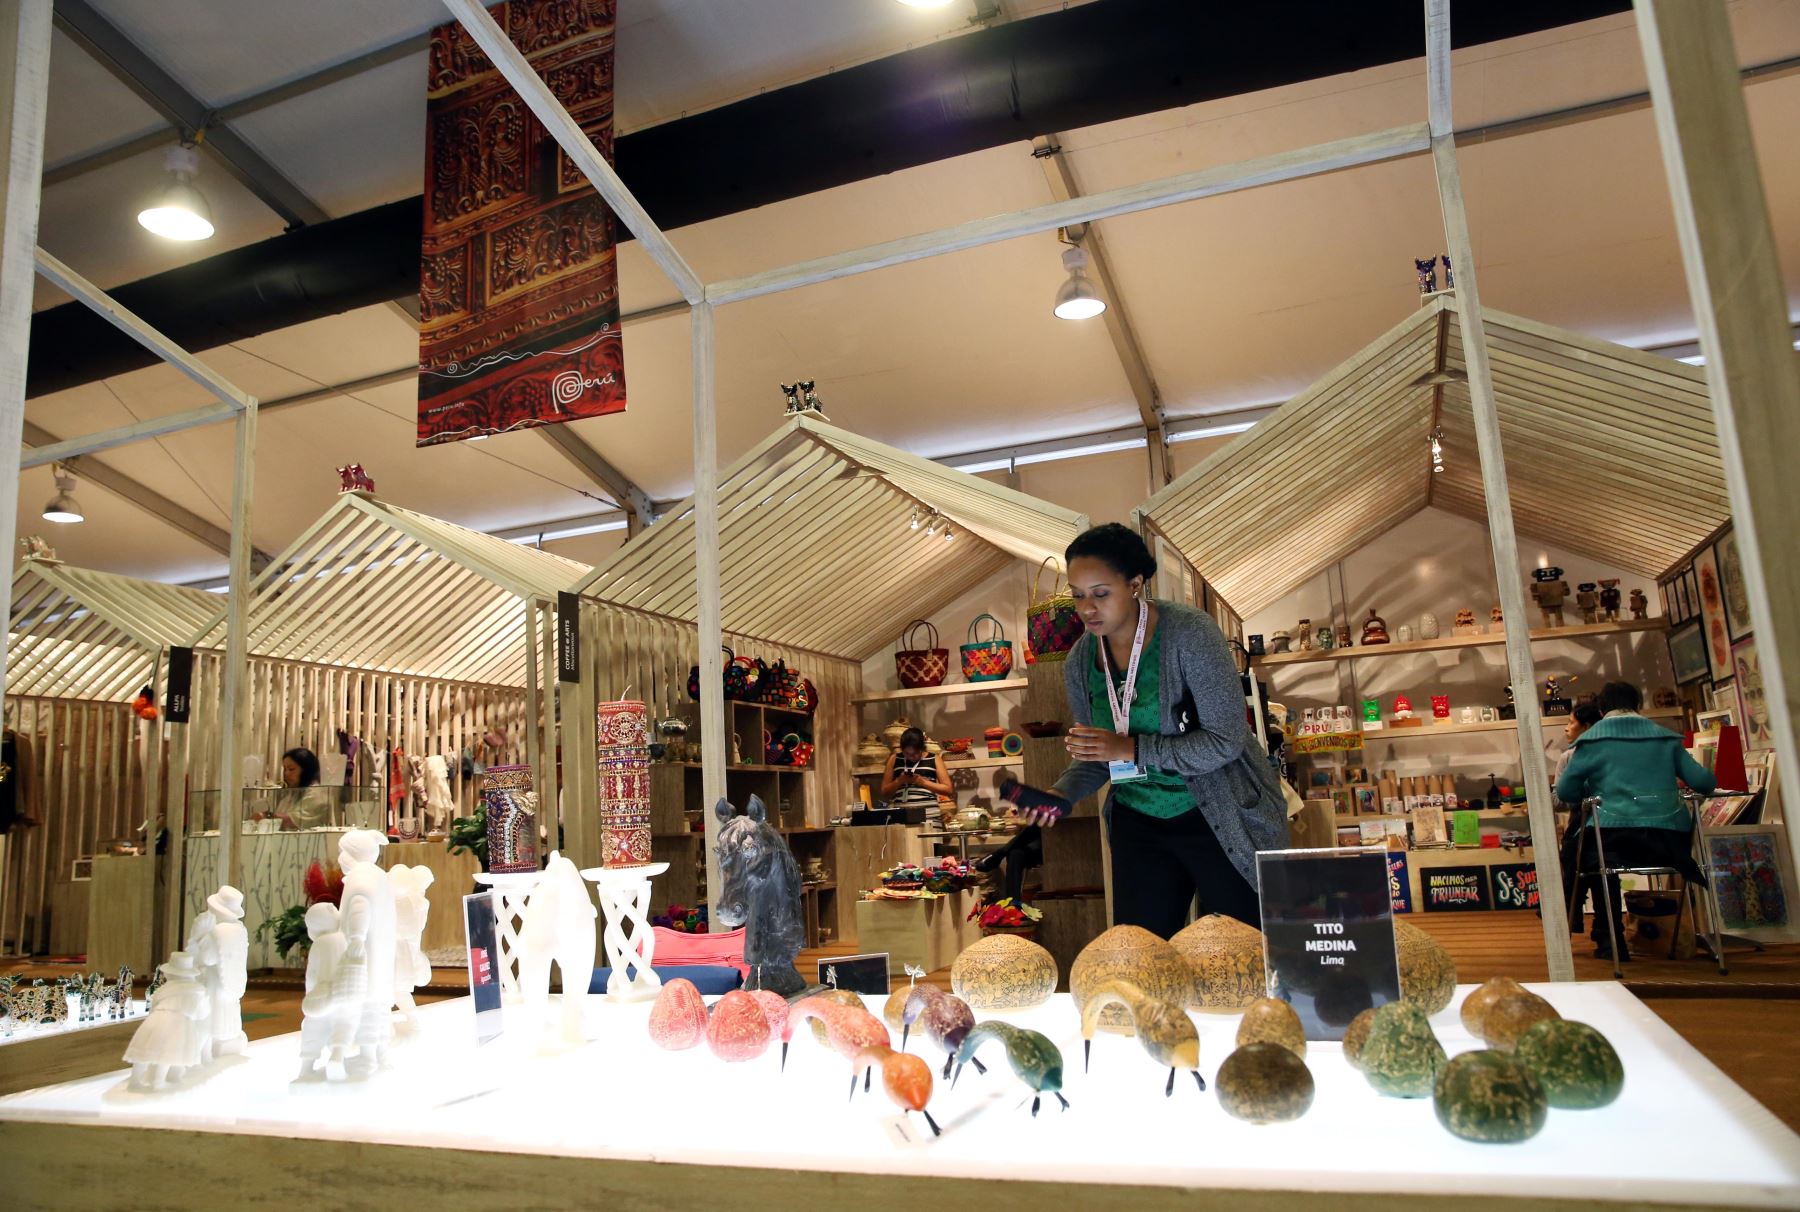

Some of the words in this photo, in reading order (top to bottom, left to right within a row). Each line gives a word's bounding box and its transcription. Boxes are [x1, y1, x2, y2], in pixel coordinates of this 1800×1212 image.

[1313, 922, 1344, 935] TITO
[1305, 939, 1357, 952] MEDINA
[1320, 954, 1345, 966] Lima
